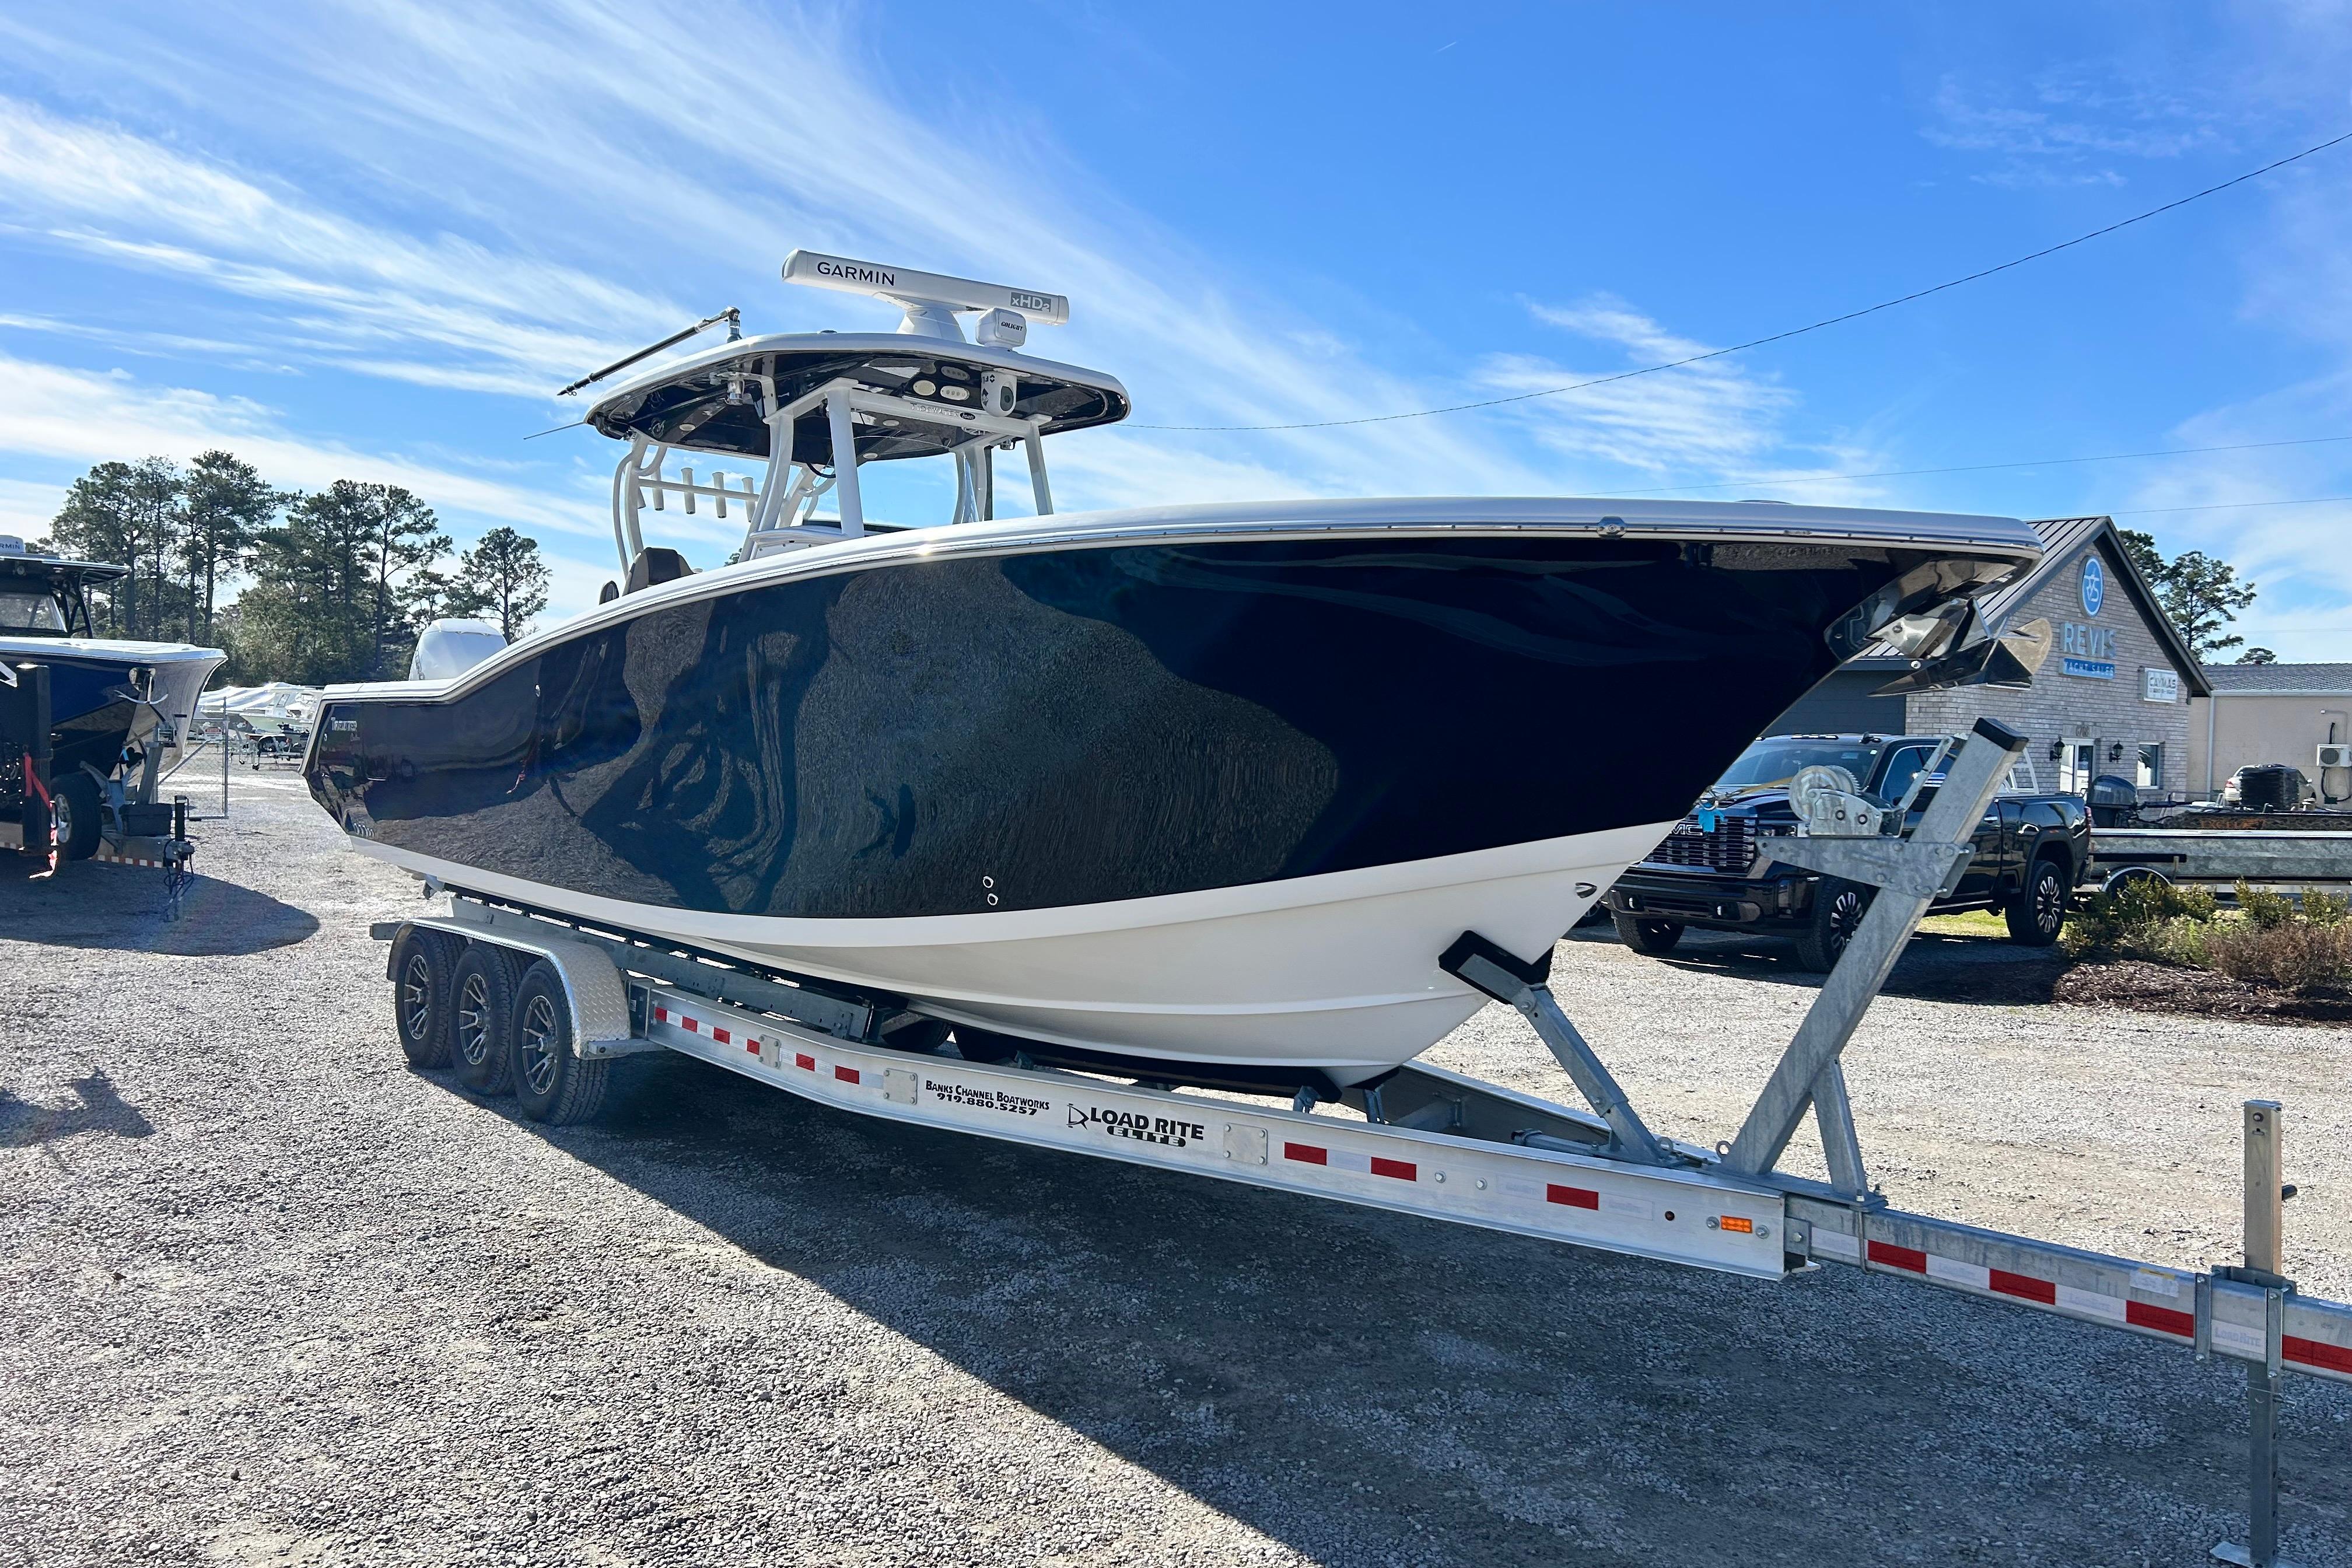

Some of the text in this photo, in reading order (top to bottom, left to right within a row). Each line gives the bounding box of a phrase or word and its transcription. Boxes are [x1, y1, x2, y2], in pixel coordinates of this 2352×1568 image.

[817, 262, 894, 286] GARMIN
[1012, 295, 1050, 312] xHD2
[1001, 321, 1023, 331] GOLIGHT
[2064, 622, 2117, 659] REVIS
[2064, 661, 2114, 676] YACHT SALES
[1670, 824, 1703, 836] MC
[926, 1080, 1049, 1110] BANKS CHANNEL BOATWORKS
[937, 1093, 1037, 1115] 919.880.5257
[1090, 1107, 1204, 1140] LOAD RITE
[1113, 1126, 1180, 1147] ELITE
